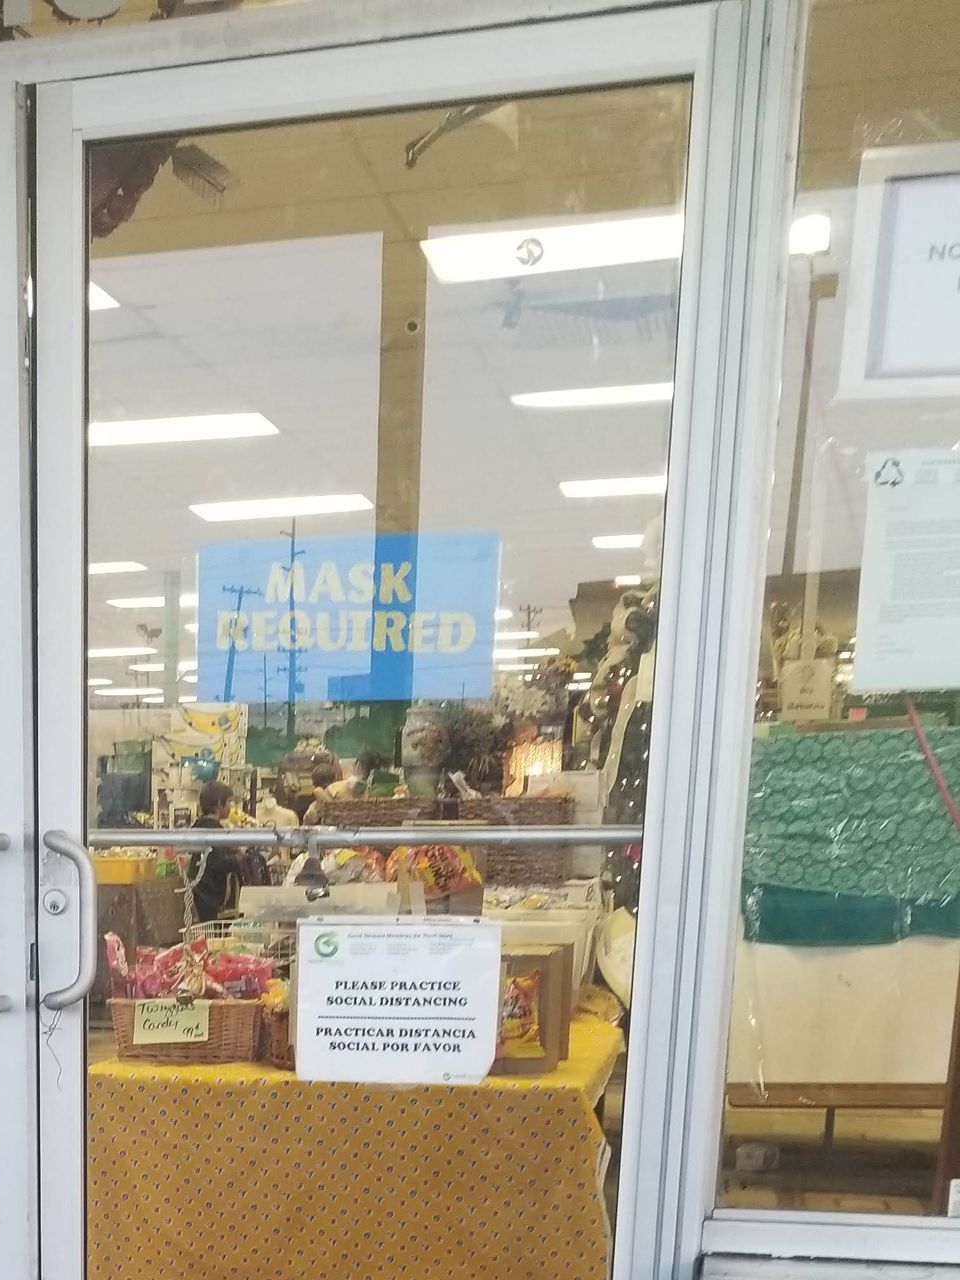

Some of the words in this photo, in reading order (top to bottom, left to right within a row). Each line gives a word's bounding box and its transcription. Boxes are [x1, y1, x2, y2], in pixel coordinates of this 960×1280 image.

[264, 560, 413, 604] MASK
[215, 610, 477, 653] REQUIRED
[334, 980, 386, 991] PLEASE
[390, 980, 461, 991] PRACTICE
[326, 996, 376, 1006] SOCIAL
[379, 996, 468, 1007] DISTANCING
[315, 1027, 394, 1038] PRACTICAR
[398, 1028, 476, 1039] DISTANCIA
[329, 1041, 378, 1051] SOCIAL
[382, 1042, 409, 1052] POR
[413, 1042, 461, 1053] FAVOR
